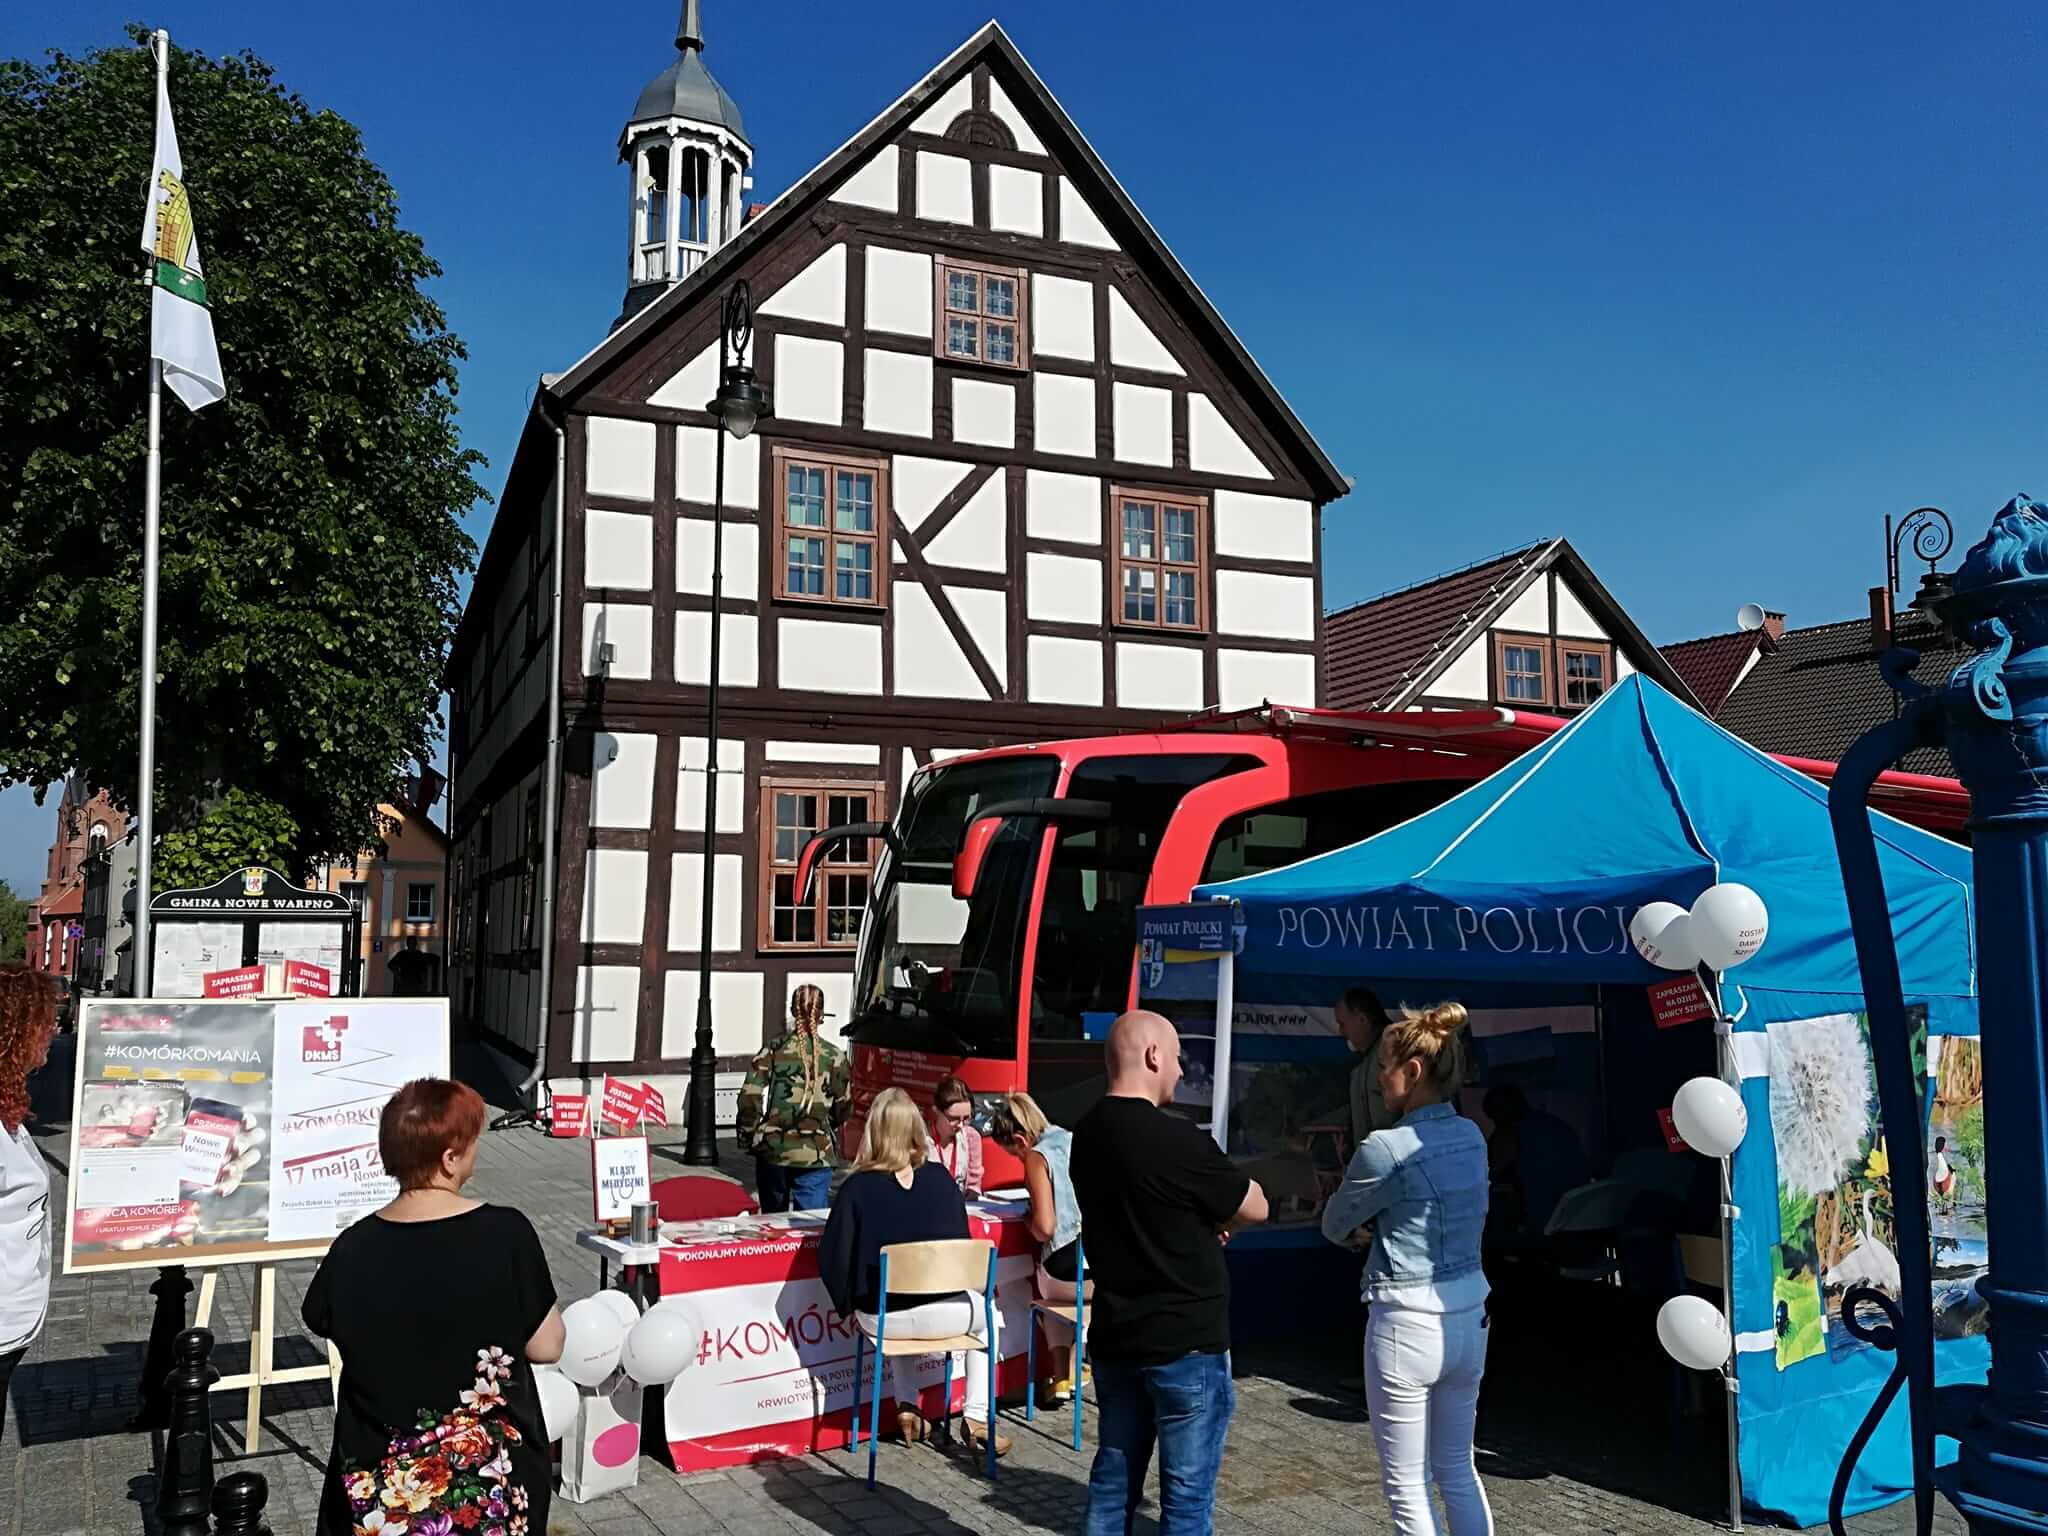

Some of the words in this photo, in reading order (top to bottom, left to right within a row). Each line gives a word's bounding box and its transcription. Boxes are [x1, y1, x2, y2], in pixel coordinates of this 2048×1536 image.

[170, 898, 221, 909] GMINA
[225, 898, 270, 909] NOWE
[273, 899, 334, 909] WARPNO
[1143, 921, 1180, 936] POWIAT
[1182, 920, 1223, 935] POLICKI
[1275, 904, 1440, 951] POWIAT
[1454, 905, 1634, 955] POLIC
[1658, 1008, 1684, 1020] DAWCY
[103, 1044, 262, 1064] #KOMÓRKOMANIA
[304, 1050, 339, 1061] DKMS
[285, 1166, 304, 1185] 17
[312, 1156, 360, 1180] maja
[366, 1148, 382, 1167] 2
[83, 1207, 128, 1218] DWCĄ
[677, 1248, 737, 1263] POKONAJMY
[739, 1241, 802, 1257] NOWOTWORY
